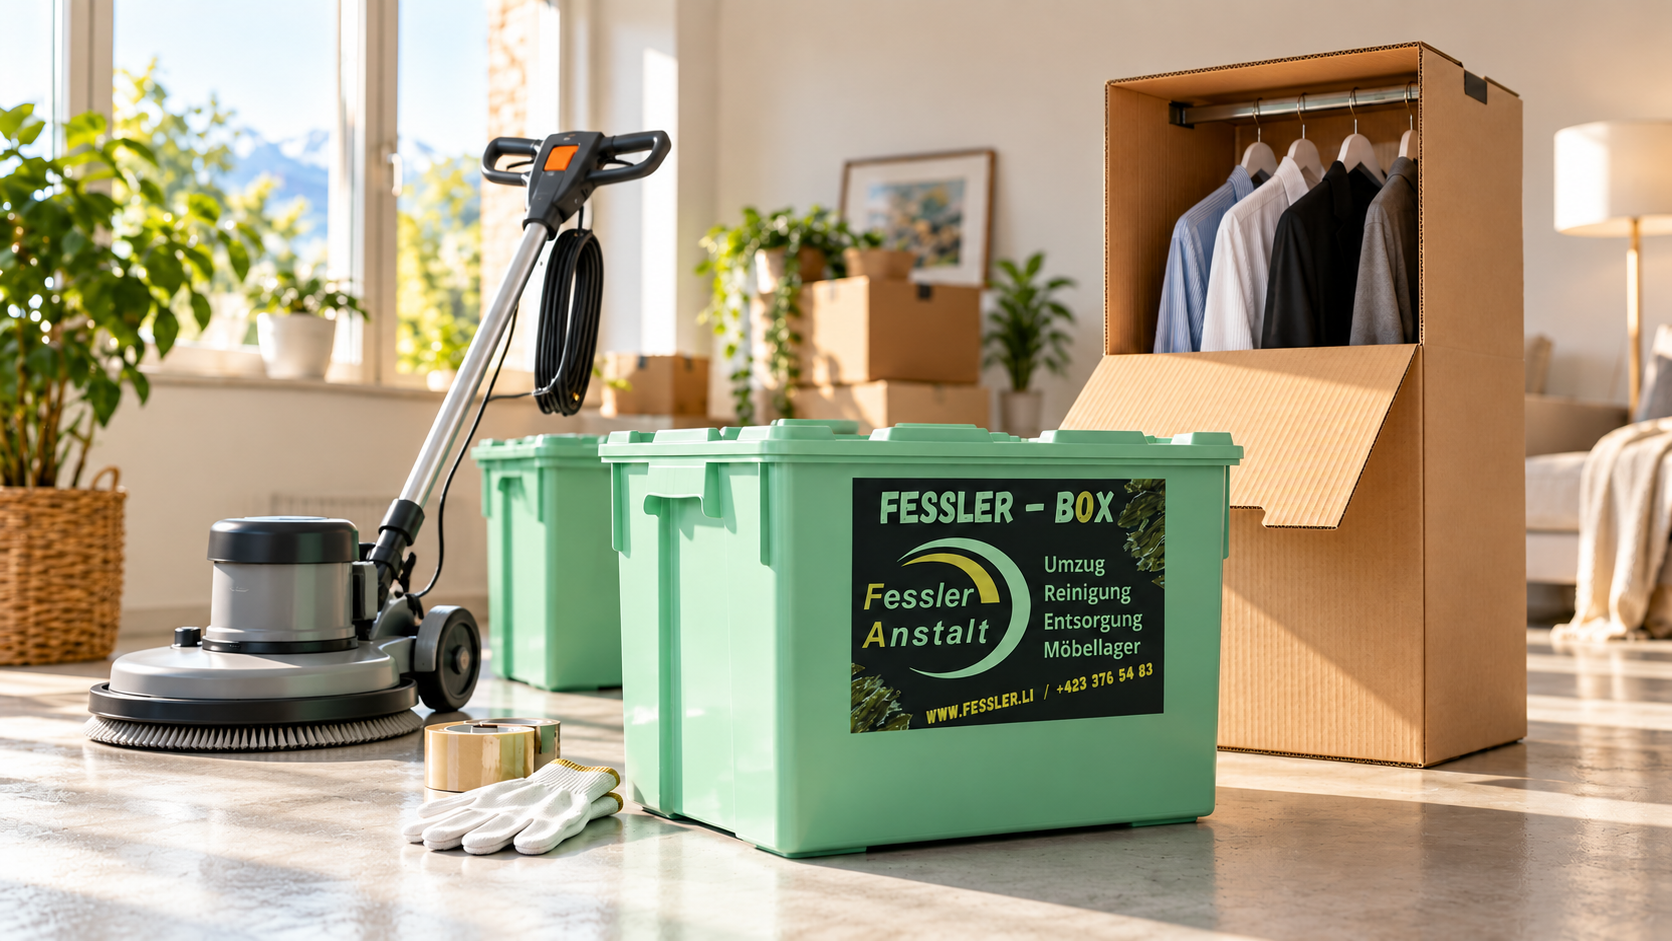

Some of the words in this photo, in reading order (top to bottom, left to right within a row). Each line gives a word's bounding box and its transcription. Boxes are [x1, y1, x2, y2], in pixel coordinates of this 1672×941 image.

[880, 491, 1014, 524] FESSLER
[1054, 490, 1115, 524] BOX
[1044, 555, 1106, 576] Umzug
[863, 582, 974, 610] Fessler
[1044, 584, 1132, 605] Reinigung
[862, 618, 990, 649] Anstalt
[1044, 611, 1143, 633] Entsorgung
[1044, 638, 1141, 659] Möbellager
[926, 689, 1034, 725] WWW.FESSLER.LI
[1043, 684, 1050, 700] /
[1056, 677, 1087, 695] +423
[1091, 672, 1114, 688] 376
[1118, 667, 1135, 683] 54
[1138, 662, 1154, 678] 83
